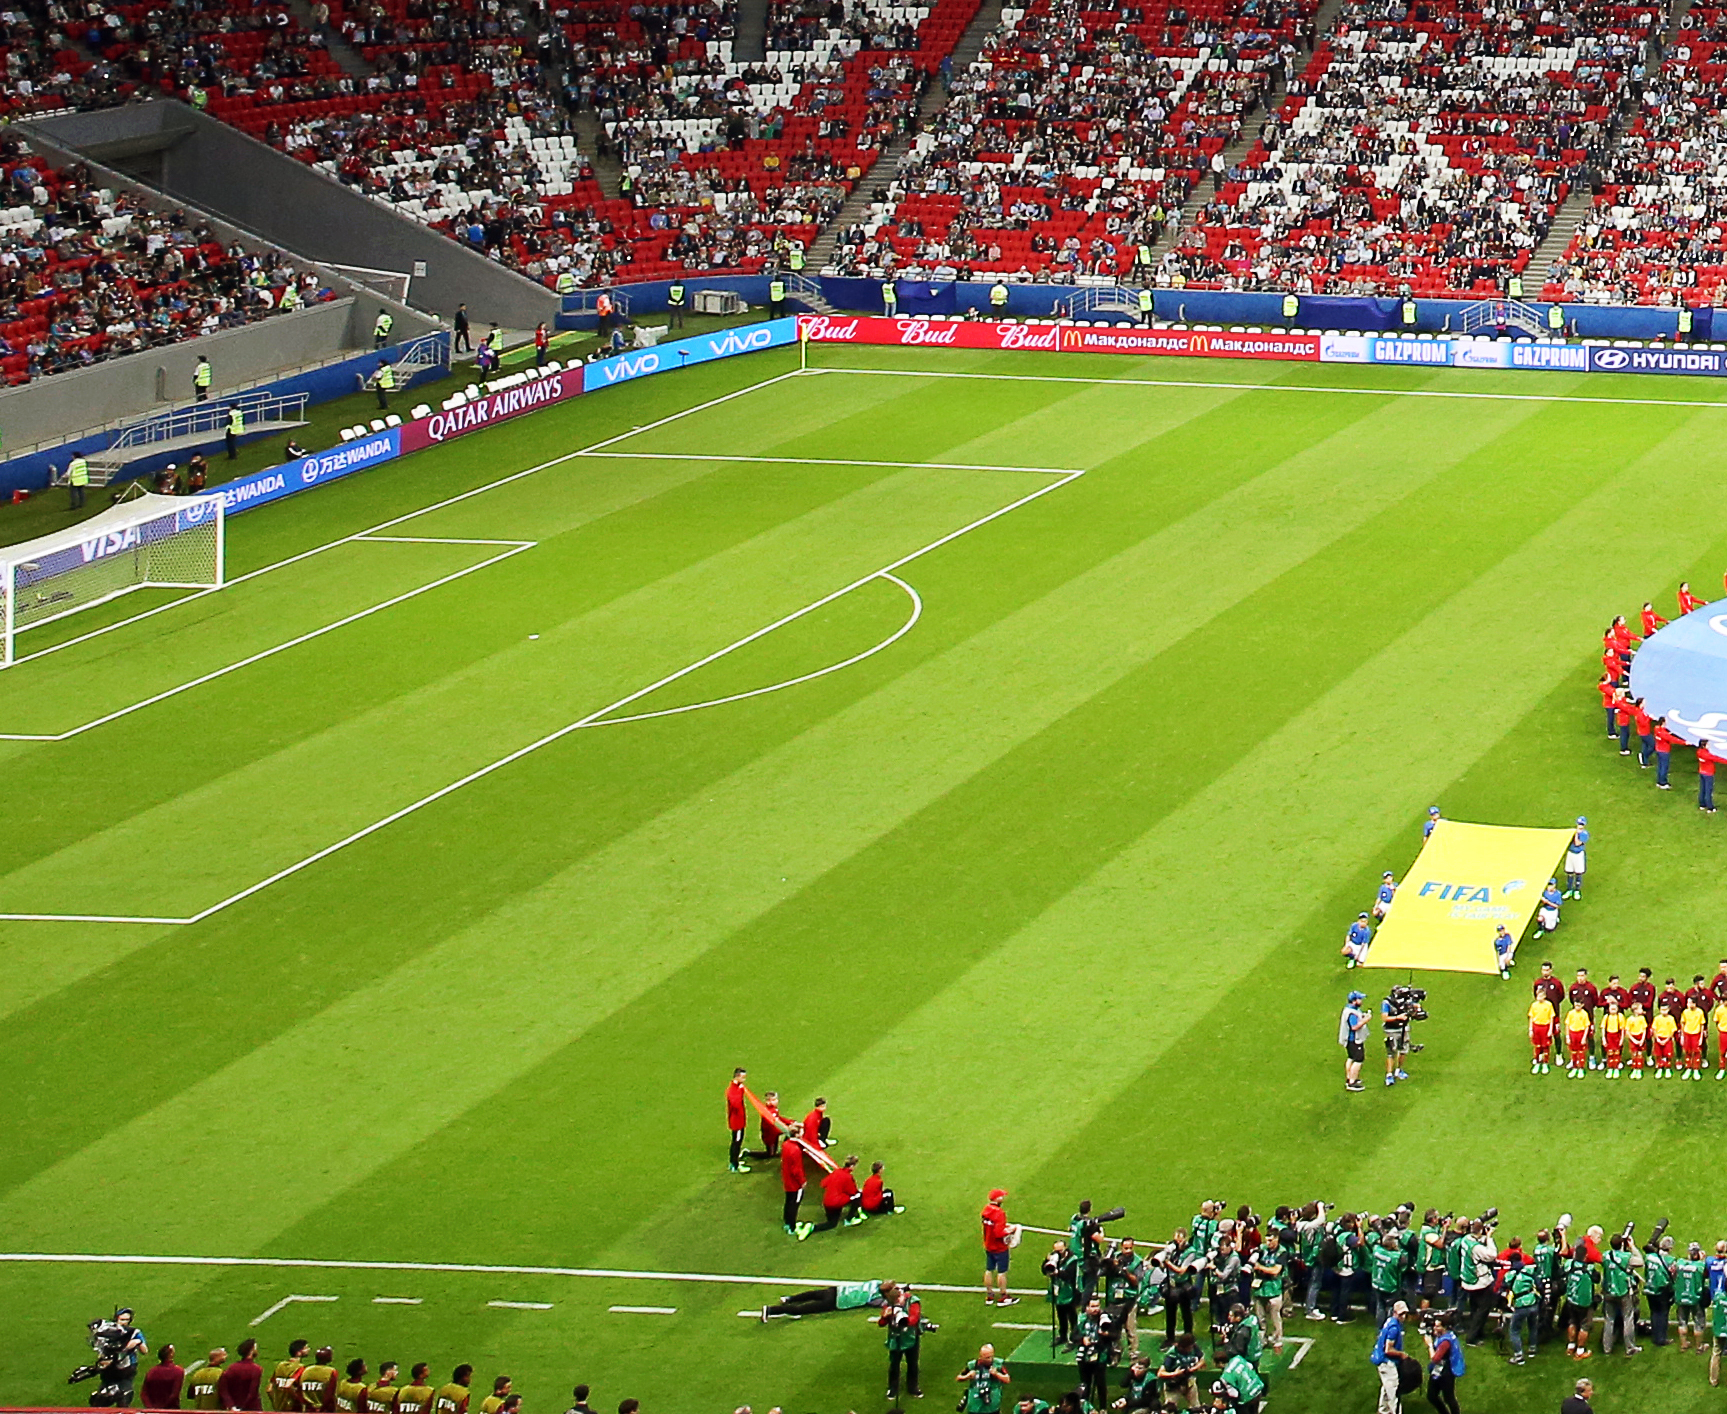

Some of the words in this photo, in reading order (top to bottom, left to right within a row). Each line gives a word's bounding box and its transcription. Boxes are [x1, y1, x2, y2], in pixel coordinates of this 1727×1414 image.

[799, 315, 860, 340] Bud
[896, 319, 956, 344] Bud
[996, 323, 1055, 348] Bud
[709, 329, 772, 356] vivo
[1083, 334, 1187, 351] Макдоналдс
[1209, 339, 1314, 356] Макдоналдс
[1374, 341, 1446, 363] GAZPROM
[603, 352, 660, 382] vivo
[1513, 346, 1585, 368] GAZPROM
[1631, 353, 1720, 372] HYUNDAI
[428, 400, 488, 441] QATAR
[491, 375, 563, 420] AIRWAYS
[80, 527, 141, 563] VISA
[1418, 881, 1490, 903] FIFA
[301, 1381, 324, 1391] FIFA
[400, 1402, 422, 1413] FIFA
